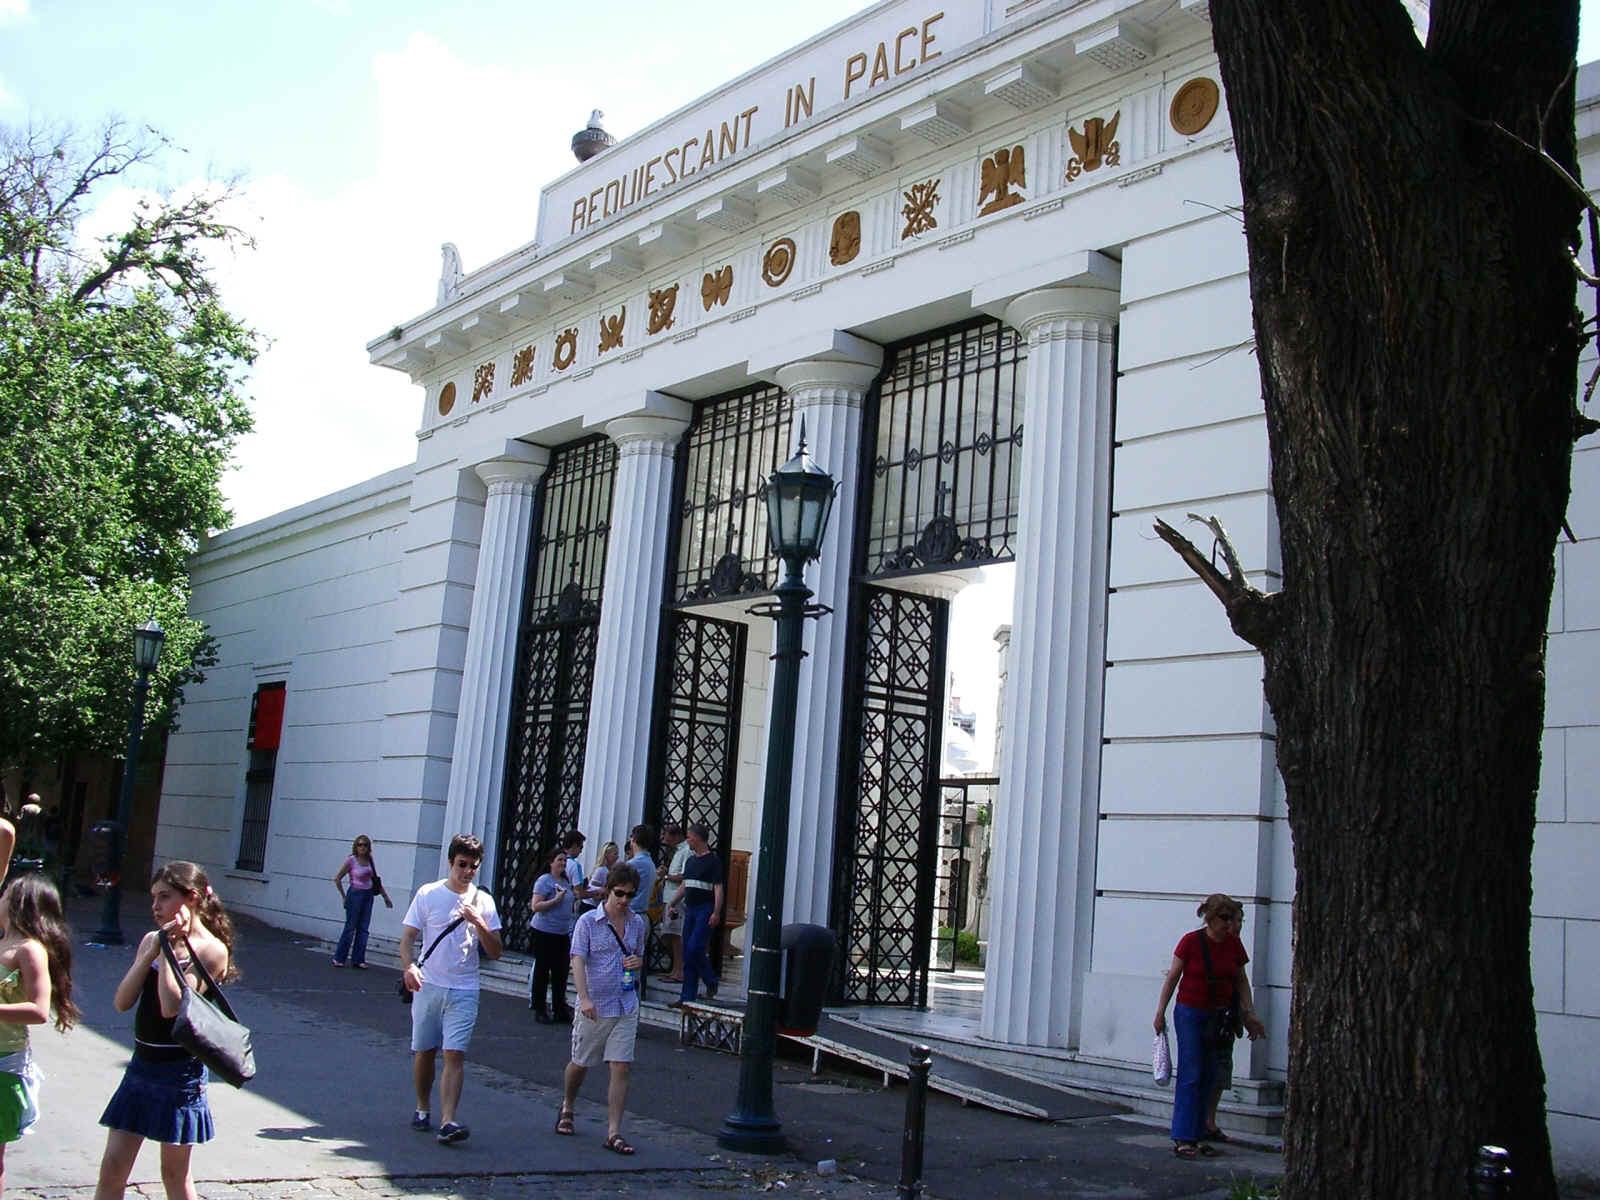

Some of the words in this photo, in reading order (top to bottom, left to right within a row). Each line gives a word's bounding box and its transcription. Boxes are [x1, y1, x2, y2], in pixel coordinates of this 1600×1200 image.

[571, 105, 759, 235] REQUIESCANT
[784, 77, 815, 128] IN
[844, 11, 945, 100] PACE
